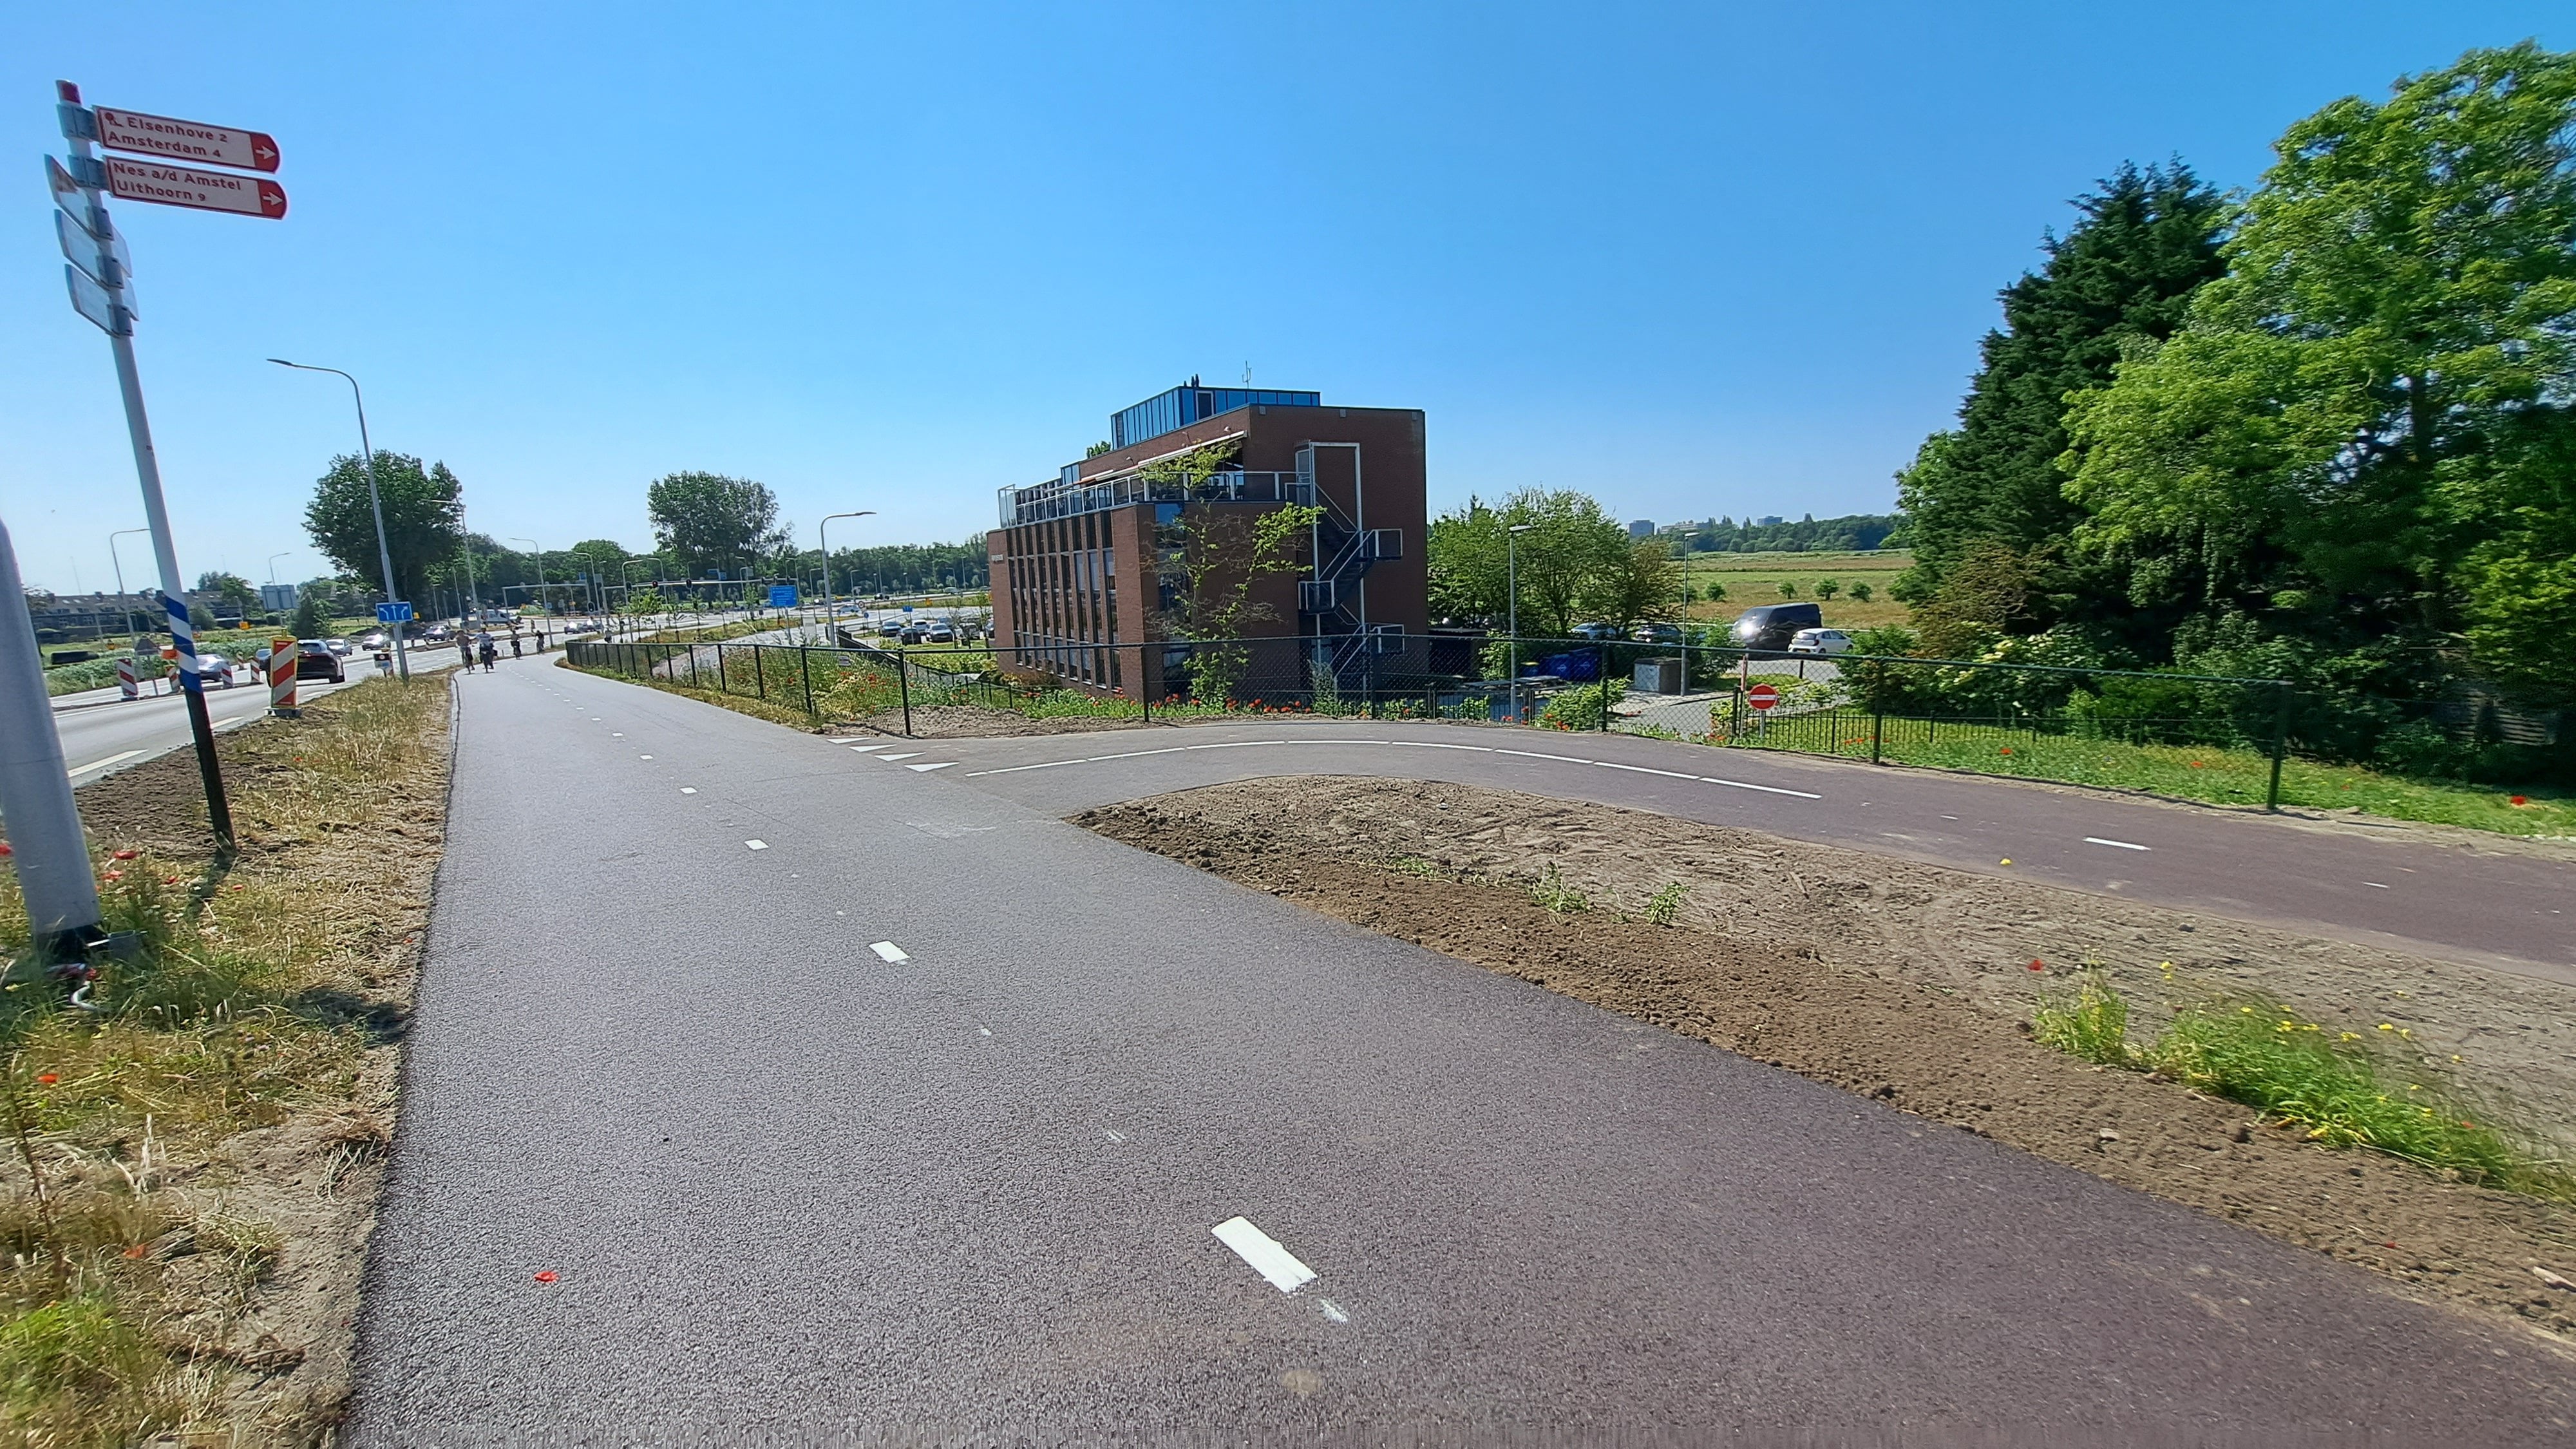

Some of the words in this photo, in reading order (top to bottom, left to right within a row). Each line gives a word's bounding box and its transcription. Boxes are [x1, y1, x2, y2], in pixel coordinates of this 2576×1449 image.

[127, 117, 214, 141] Elsenhove
[220, 133, 227, 143] 2
[108, 131, 207, 156] Amsterdam
[213, 149, 222, 158] 4
[113, 162, 146, 177] Nes
[151, 169, 179, 182] a/d
[184, 173, 242, 191] Amstel
[116, 180, 194, 200] Uithoorn
[198, 193, 207, 202] 9
